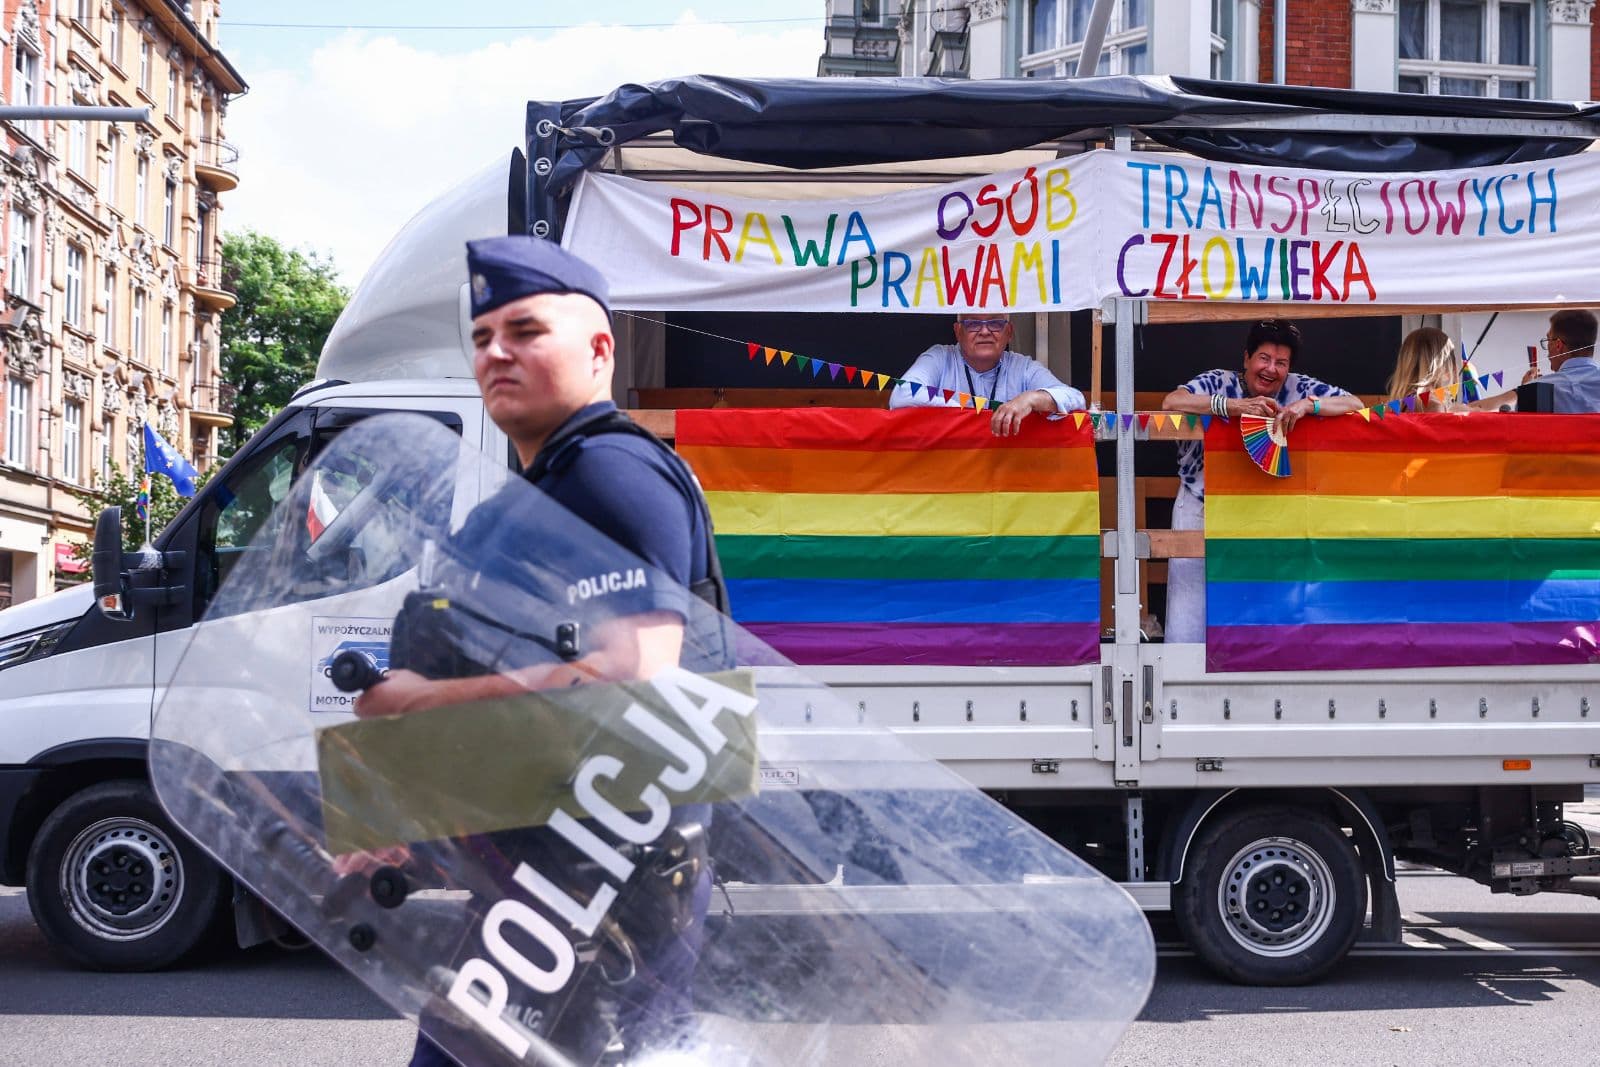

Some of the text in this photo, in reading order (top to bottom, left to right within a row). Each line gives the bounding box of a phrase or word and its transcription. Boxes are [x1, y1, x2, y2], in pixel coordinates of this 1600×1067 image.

[670, 160, 1558, 267] PRAWA OSÓB TRANSPŁCIOWYCH
[850, 232, 1378, 309] PRAWAMI CZŁOWIEKA
[566, 567, 647, 606] POLICJA
[317, 624, 394, 637] WYPOŻYCZALN
[446, 666, 760, 1060] POLICJA
